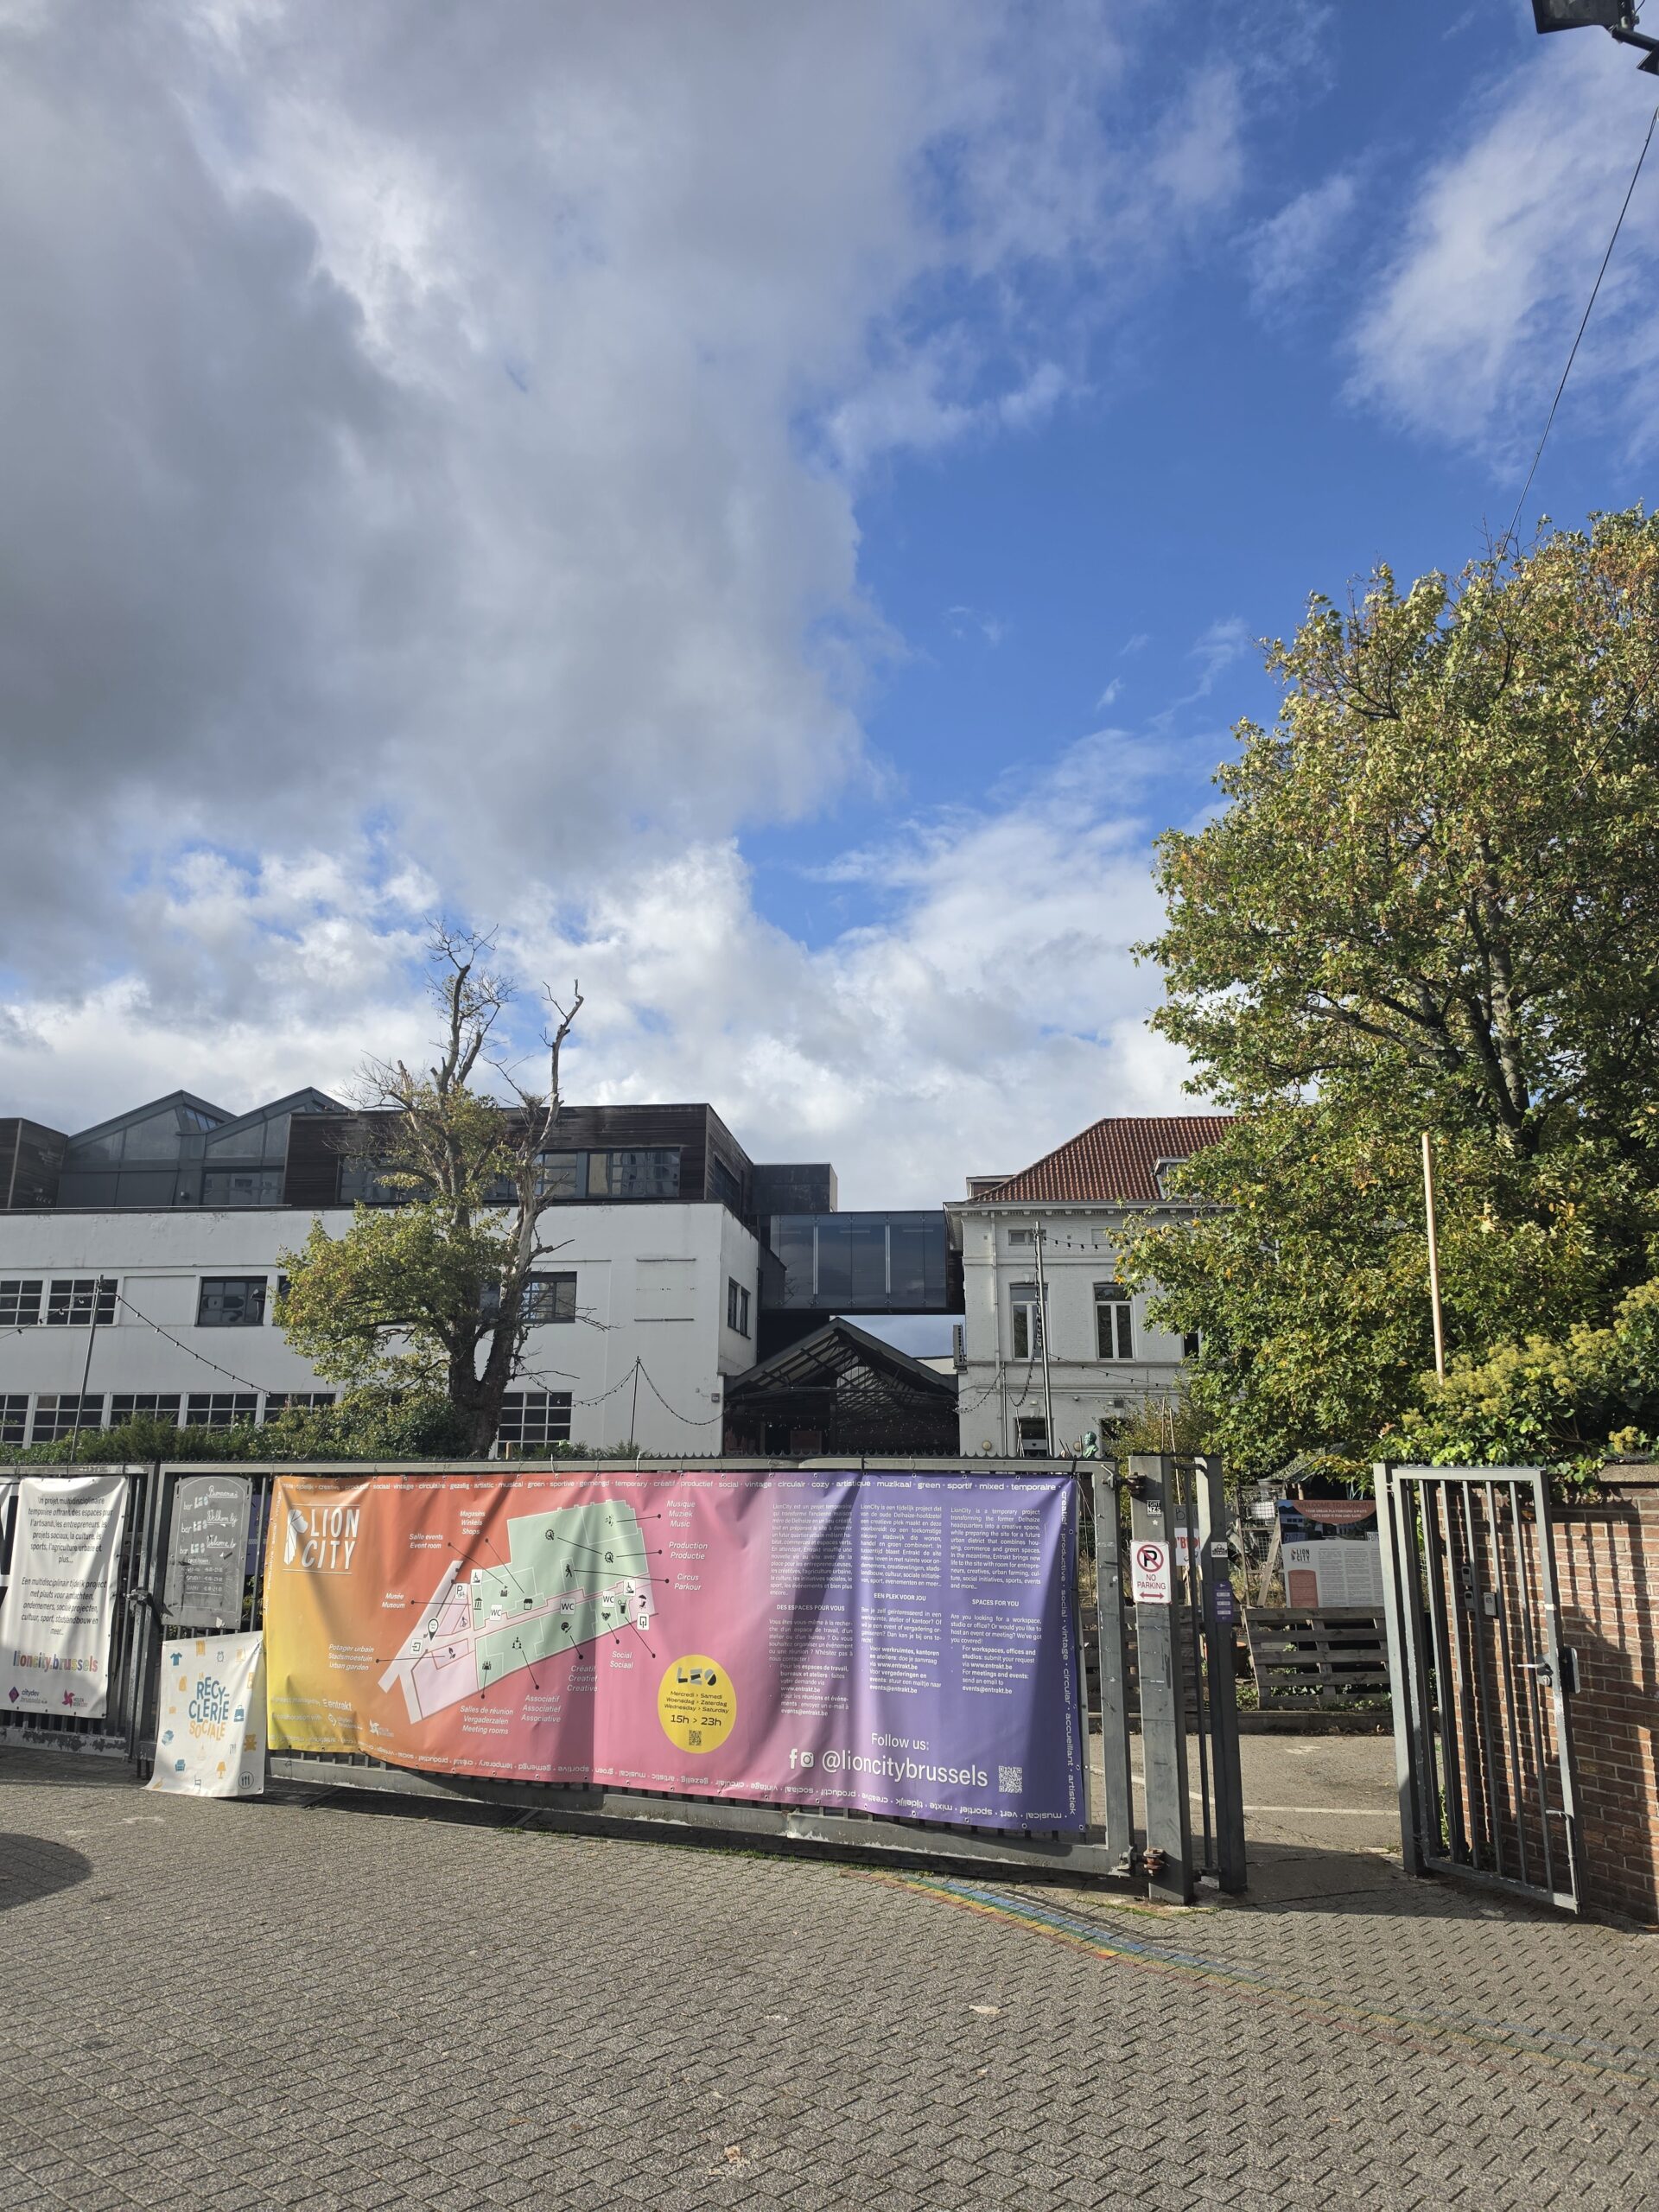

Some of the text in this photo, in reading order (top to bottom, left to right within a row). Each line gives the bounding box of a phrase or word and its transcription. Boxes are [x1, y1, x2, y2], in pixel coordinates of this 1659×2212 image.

[681, 1479, 714, 1488] productief
[836, 1479, 871, 1488] artistique
[45, 1497, 59, 1505] projet
[667, 1500, 695, 1509] Musique
[183, 1502, 192, 1510] bar
[82, 1509, 102, 1517] espaces
[181, 1523, 192, 1533] bar
[310, 1509, 359, 1538] LION
[180, 1545, 188, 1554] bar
[669, 1541, 709, 1550] Production
[302, 1540, 355, 1570] CITY
[385, 1592, 404, 1600] Musée
[41, 1614, 54, 1623] sport,
[328, 1643, 353, 1653] Potager
[13, 1650, 99, 1672] lioncity.brussels
[328, 1653, 373, 1662] Stadsmoestuin
[570, 1664, 596, 1673] Créatif
[677, 1668, 717, 1687] LEO
[22, 1688, 40, 1697] citydev
[197, 1676, 230, 1706] RECY-
[870, 1685, 918, 1694] events@entrakt.be
[963, 1685, 1013, 1694] events@entrakt.be
[328, 1700, 353, 1711] entrakt
[522, 1704, 561, 1713] Associatief
[188, 1699, 230, 1723] CLERIE
[463, 1716, 508, 1725] Vergaderzalen
[521, 1714, 561, 1723] Associative
[671, 1714, 721, 1726] 15h 23h
[189, 1719, 226, 1741] SOCIALE
[463, 1725, 487, 1735] Meeting
[871, 1732, 930, 1751] Follow us:
[418, 1756, 448, 1764] productief
[479, 1759, 512, 1769] temporary
[518, 1763, 551, 1773] gemengd
[594, 1768, 613, 1777] groen
[822, 1750, 988, 1787] @lioncitybrussels
[619, 1770, 646, 1779] musical
[652, 1773, 675, 1783] artistic
[681, 1777, 709, 1785] gezellig
[750, 1783, 778, 1792] vintage
[821, 1788, 856, 1797] productif
[861, 1793, 888, 1804] creative
[895, 1798, 923, 1809] tijdelijk
[930, 1802, 952, 1811] mixte
[959, 1806, 993, 1816] sportief
